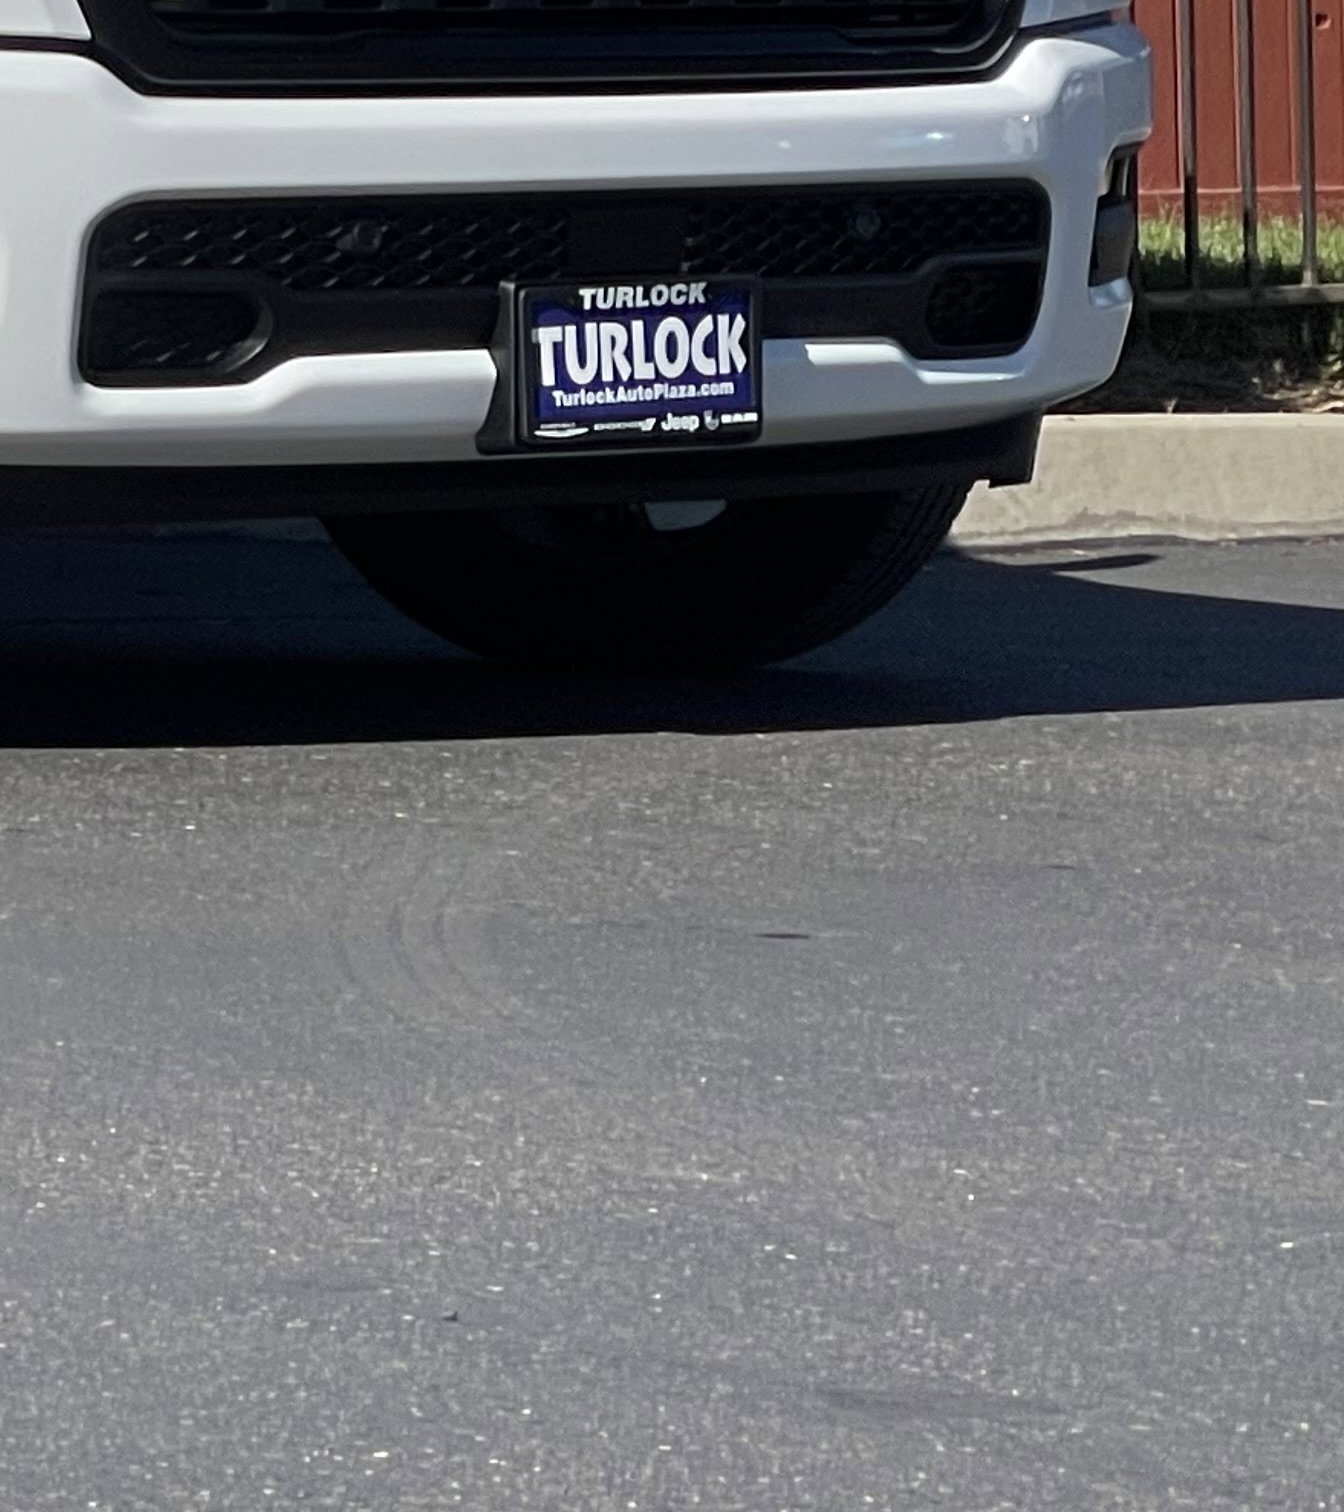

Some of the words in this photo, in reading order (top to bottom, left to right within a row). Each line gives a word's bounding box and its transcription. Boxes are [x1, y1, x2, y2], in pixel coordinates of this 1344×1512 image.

[579, 282, 707, 310] TURLOCK
[533, 313, 747, 387] TURLOCK
[552, 381, 734, 407] TurlockAutoPlaza.com
[661, 412, 699, 433] Jeep
